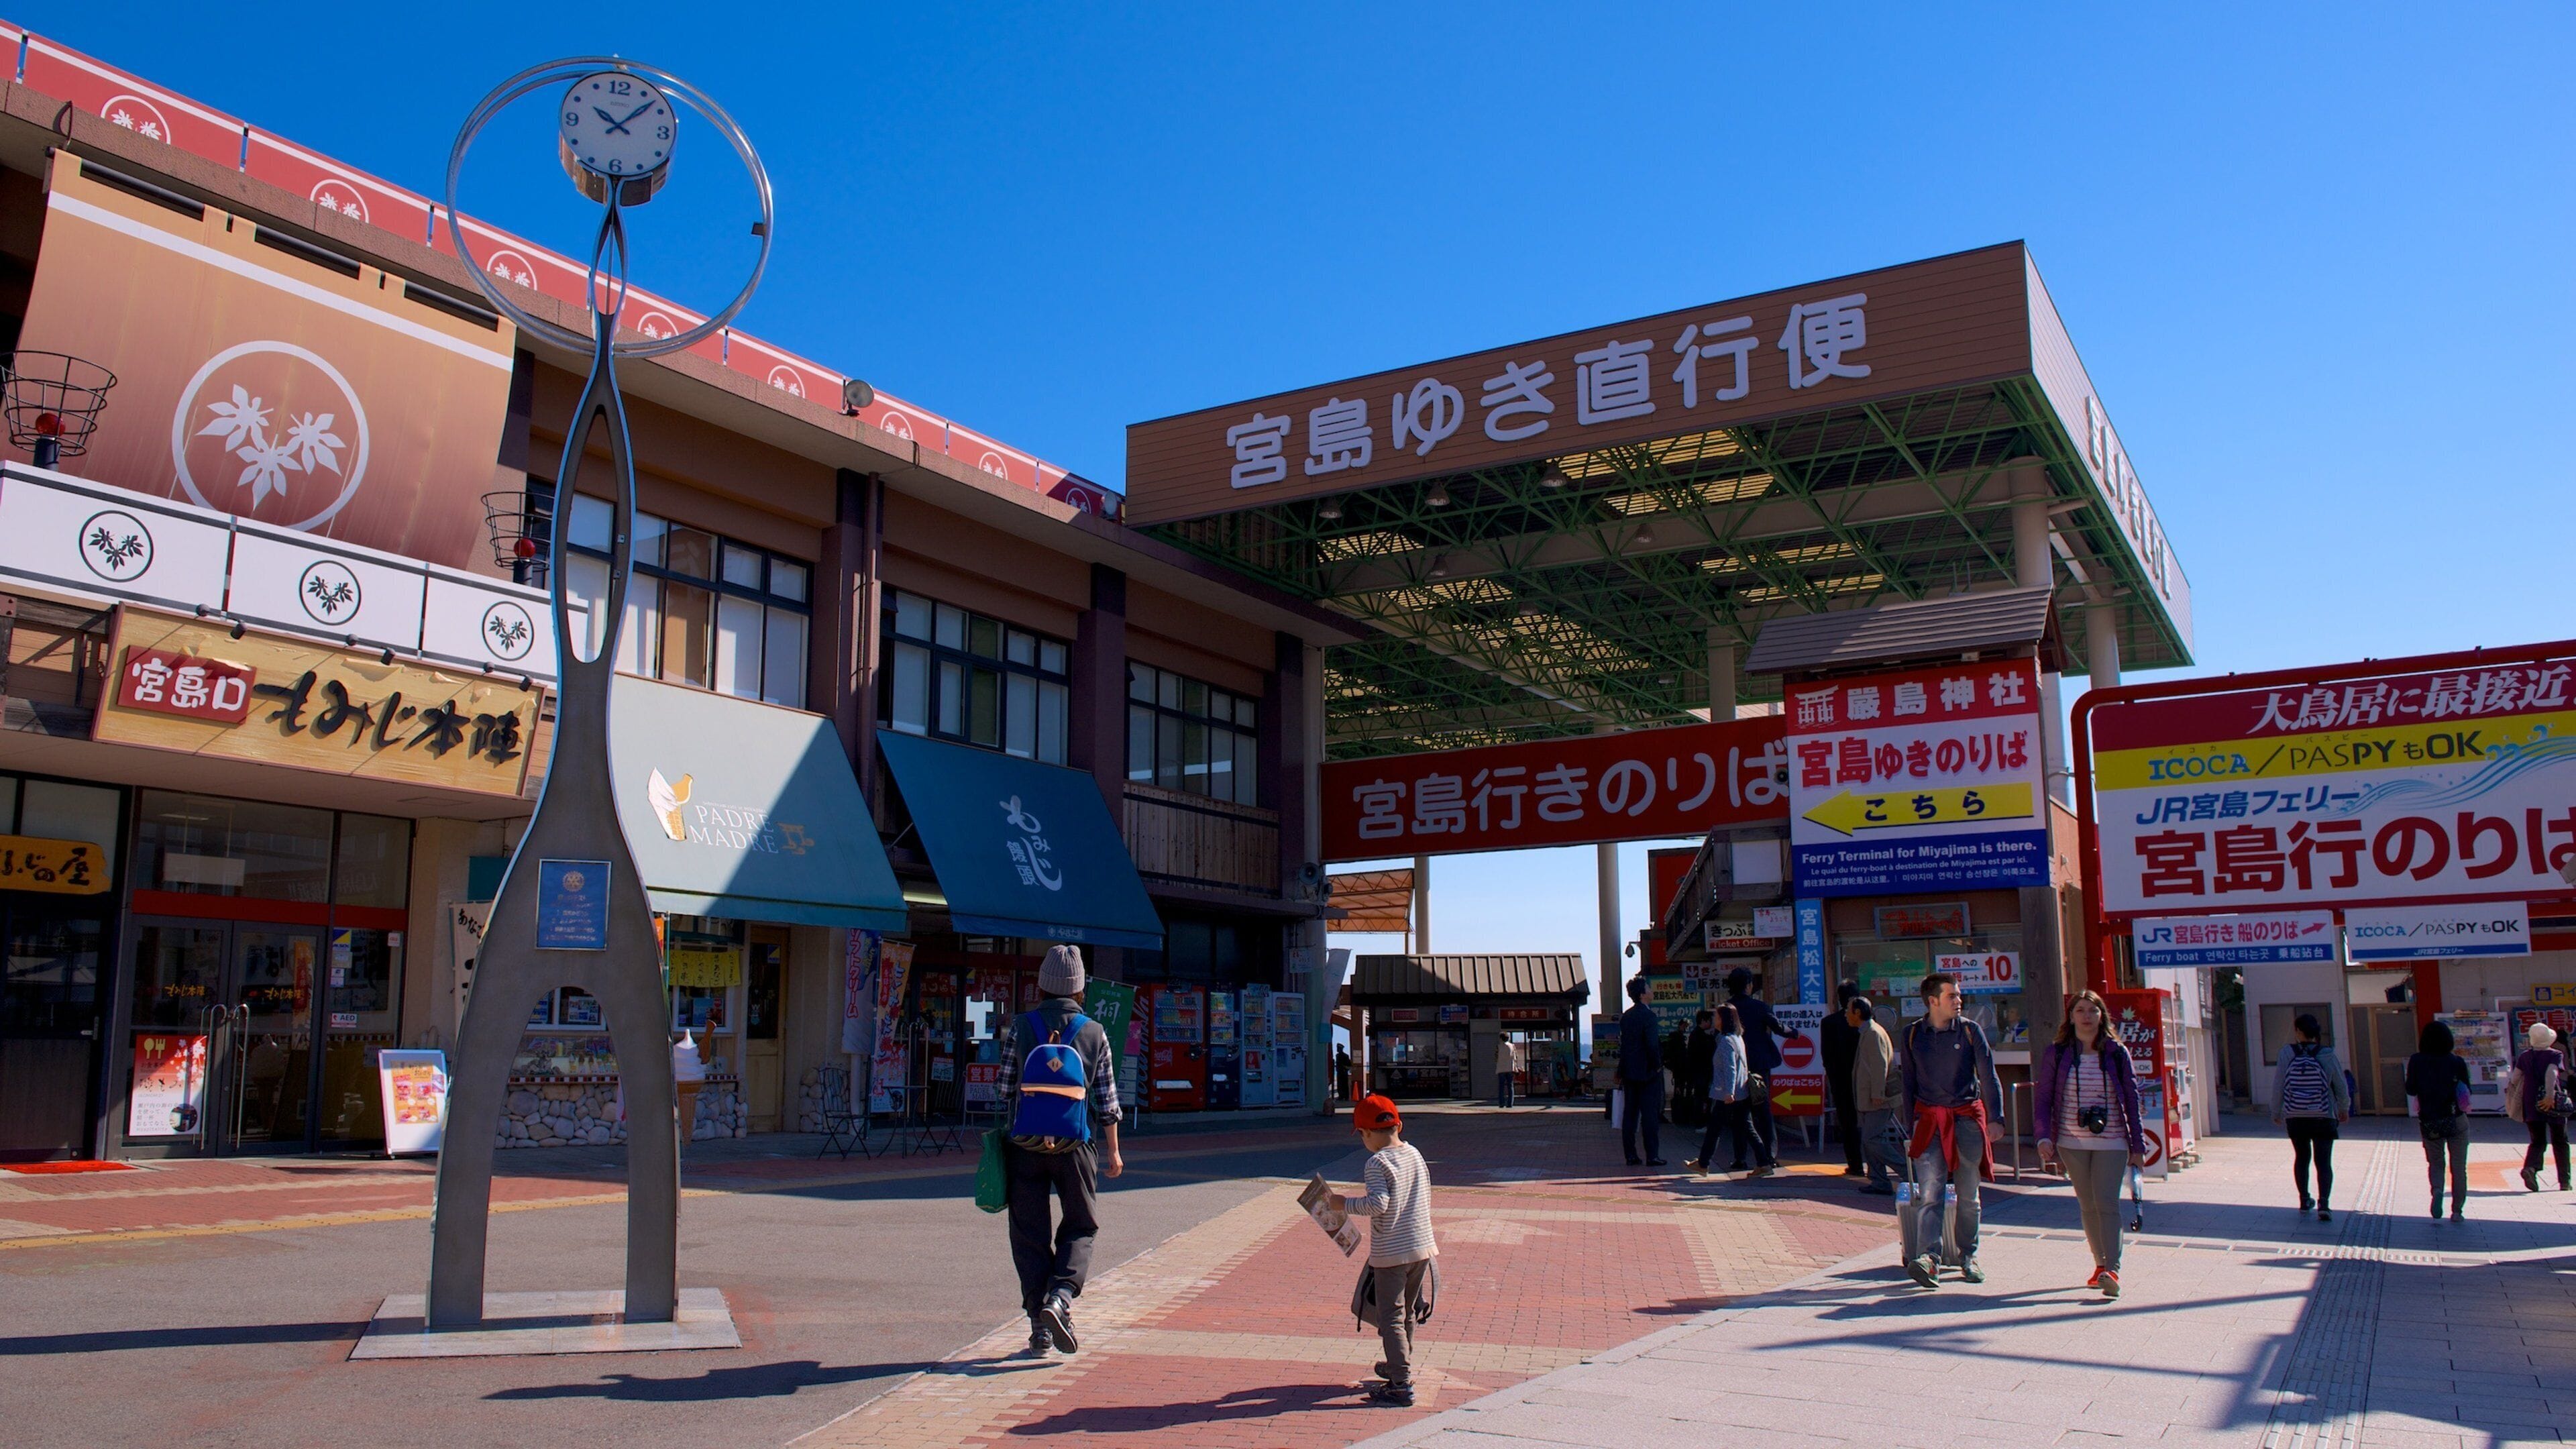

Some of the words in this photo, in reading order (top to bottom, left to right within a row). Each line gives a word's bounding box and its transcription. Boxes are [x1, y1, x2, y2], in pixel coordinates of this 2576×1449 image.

[608, 80, 631, 96] 12
[566, 113, 579, 126] 9
[657, 126, 669, 140] 3
[608, 159, 622, 173] 6
[1226, 293, 1872, 488] 宮島ゆき直行便
[2246, 664, 2576, 734] 大鳥居に最接近
[132, 657, 248, 712] 宮島口
[255, 671, 521, 764] もみじ本陣
[1797, 730, 2028, 788] 宮島ゆきのりば
[1352, 739, 1789, 840] 宮島行きのりば
[1865, 791, 1986, 822] こちら
[2137, 786, 2359, 824] JR宮島フェリー
[696, 805, 774, 833] PADRE
[690, 824, 778, 853] MADRE
[1803, 853, 1835, 865] Ferry
[1838, 848, 1893, 861] Terminal
[1897, 847, 1915, 858] for
[1919, 844, 1976, 858] Miyajima
[1981, 843, 1992, 853] is
[1996, 841, 2037, 851] there.
[1821, 867, 1837, 876] quai
[1850, 863, 1887, 874] ferry-boat
[1895, 861, 1937, 871] destination
[1951, 859, 1986, 868] Miyajima
[2002, 858, 2015, 866] par
[1902, 873, 1933, 881] 미야지마
[1713, 940, 1740, 948] Ticket
[1743, 938, 1770, 947] Office
[2175, 924, 2234, 945] 宮島行き
[2238, 921, 2298, 943] 船のりば
[1941, 957, 1978, 968] 宮島への
[2145, 951, 2171, 963] Ferry
[2176, 951, 2199, 961] boat
[2206, 949, 2236, 961] 연락선
[2239, 948, 2270, 961] 타는곳
[847, 928, 861, 1018] ソフトクリーム
[1985, 955, 2012, 981] 10
[1508, 1010, 1539, 1018] 待合所
[971, 1067, 1000, 1082] 営業
[1772, 1079, 1822, 1087] のりばはこちら
